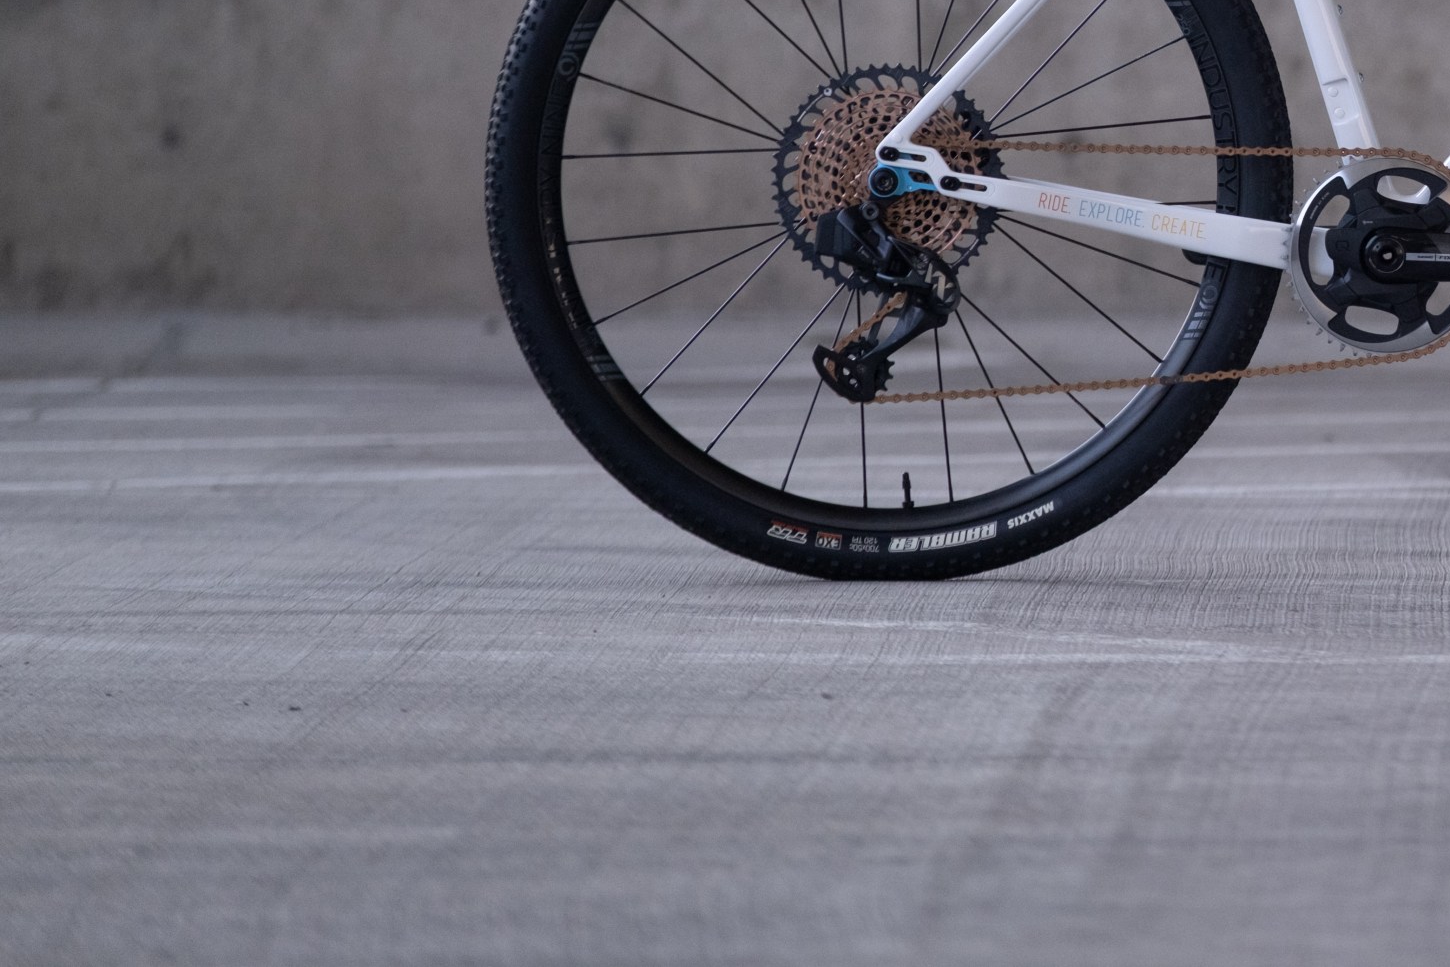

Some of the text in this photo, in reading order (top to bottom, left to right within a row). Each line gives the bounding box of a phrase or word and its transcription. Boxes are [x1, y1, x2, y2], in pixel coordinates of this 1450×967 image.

[1187, 33, 1238, 195] INDUSTRY
[1038, 192, 1071, 214] RIDE.
[1079, 199, 1145, 228] EXPLORE.
[1007, 500, 1055, 530] MAXXIS
[816, 535, 841, 549] EXO
[888, 520, 997, 552] RAMBLER
